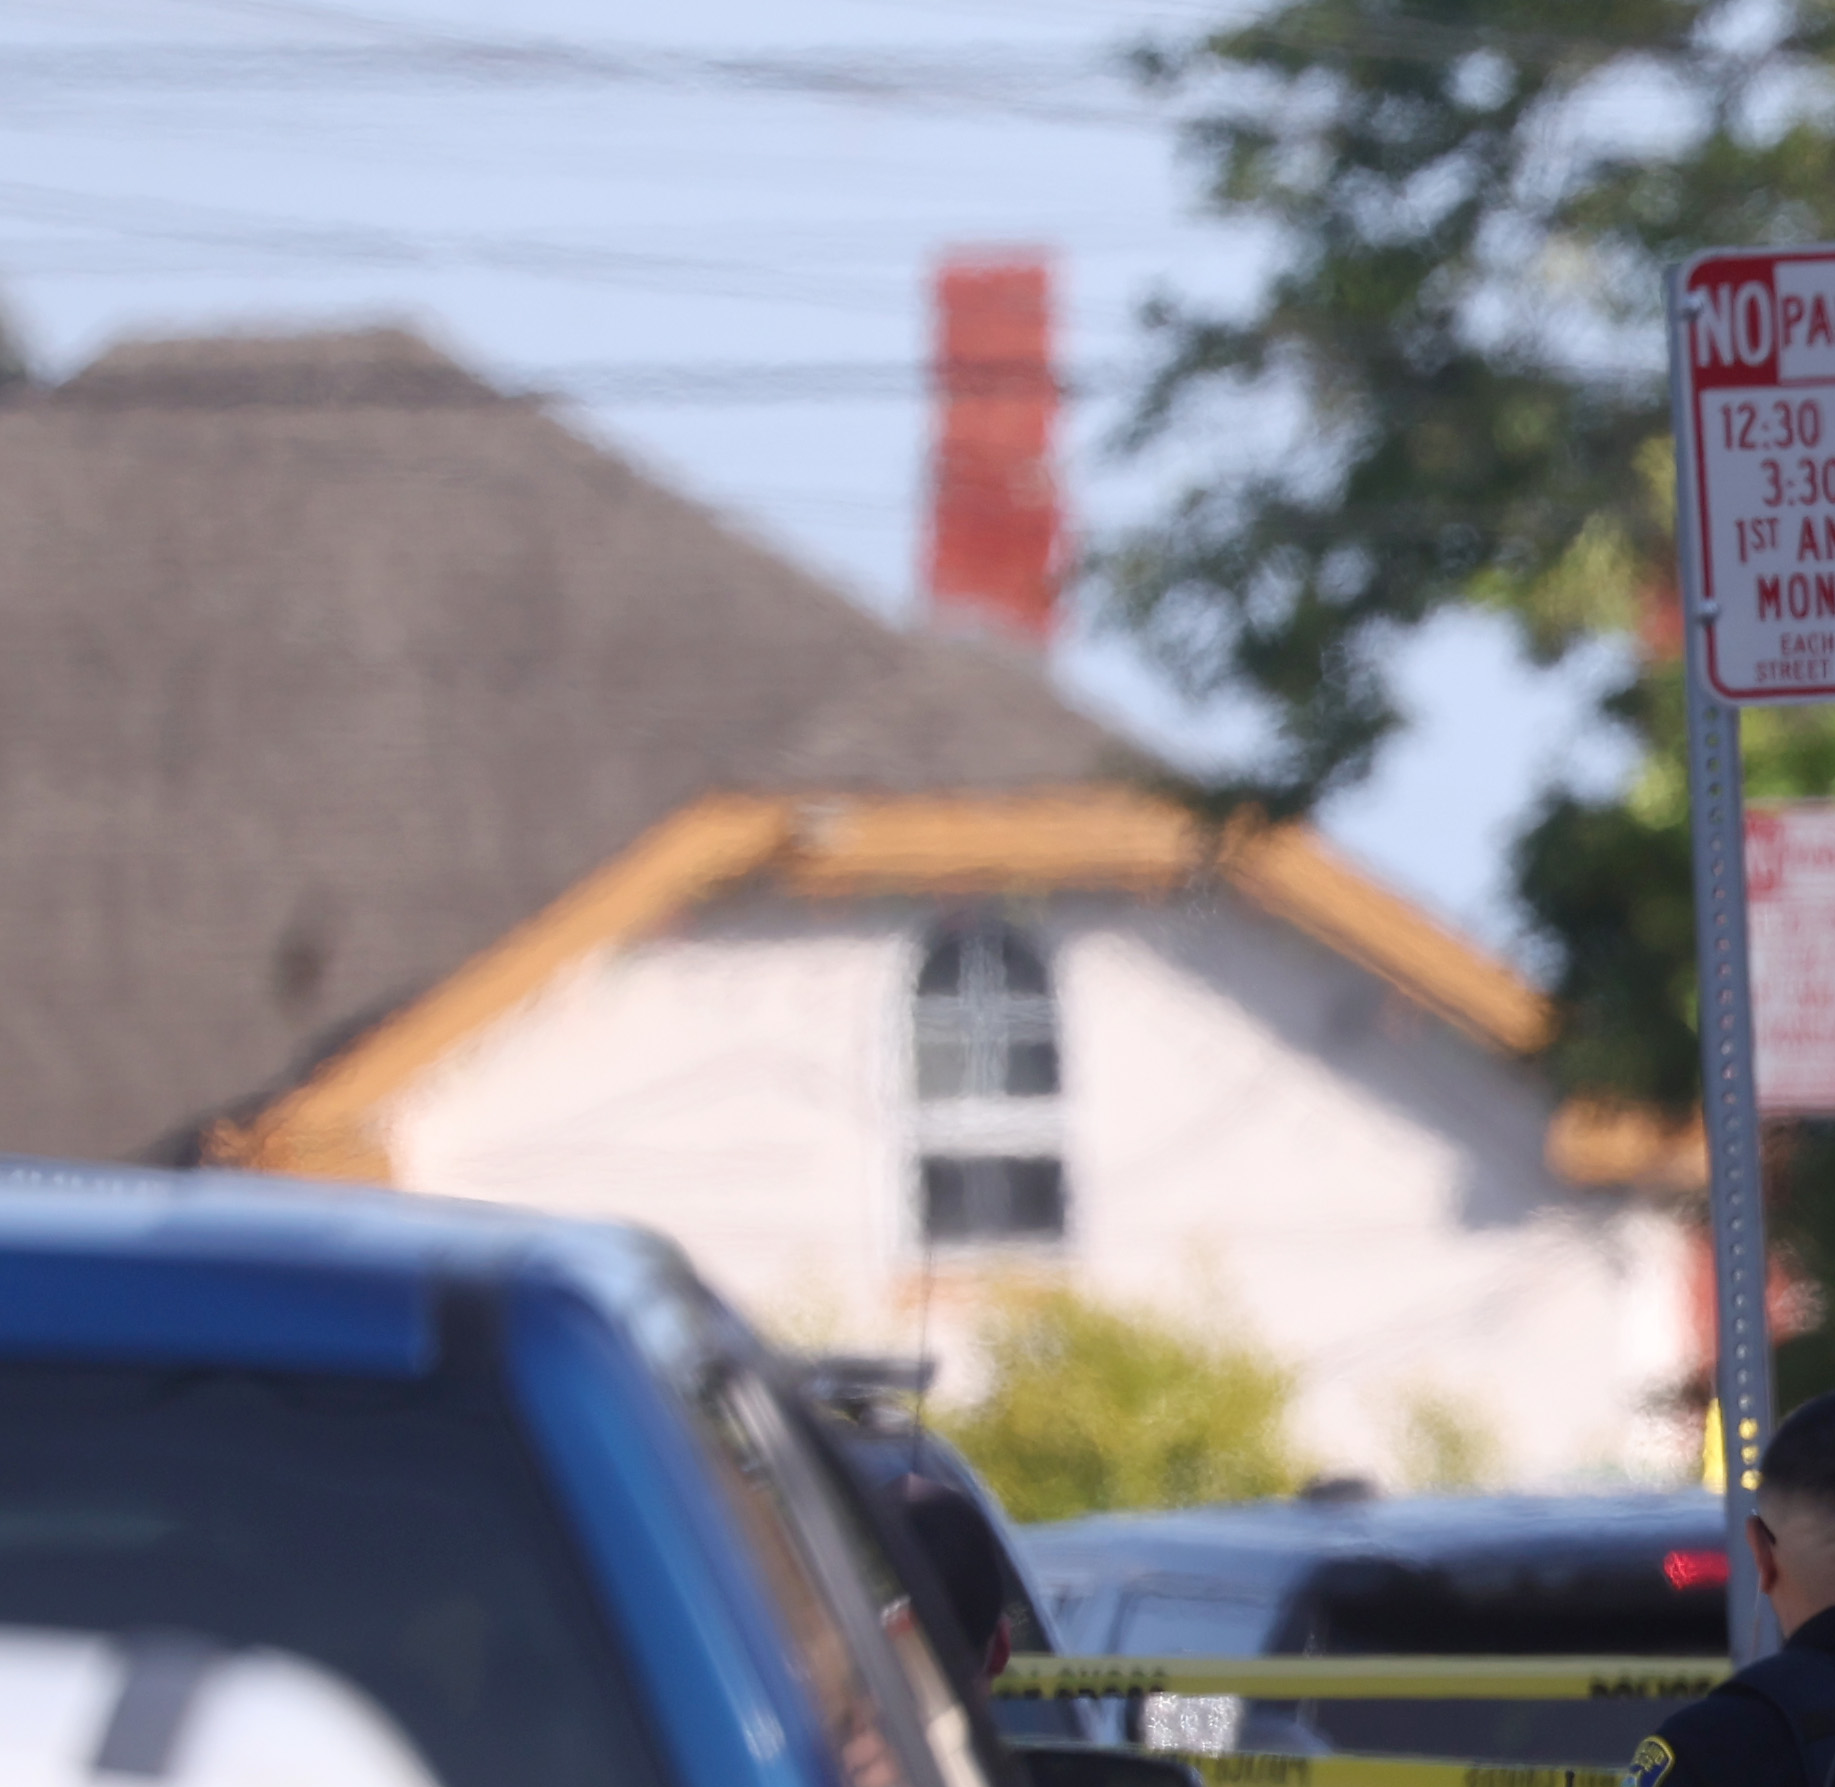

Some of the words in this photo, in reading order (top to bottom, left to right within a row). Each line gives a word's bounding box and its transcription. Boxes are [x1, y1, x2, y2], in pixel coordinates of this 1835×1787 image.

[1700, 280, 1773, 368] NO
[1721, 400, 1821, 450] 12:30
[1736, 516, 1779, 566] 1ST
[1780, 632, 1834, 656] EACH
[1756, 659, 1829, 682] STREET
